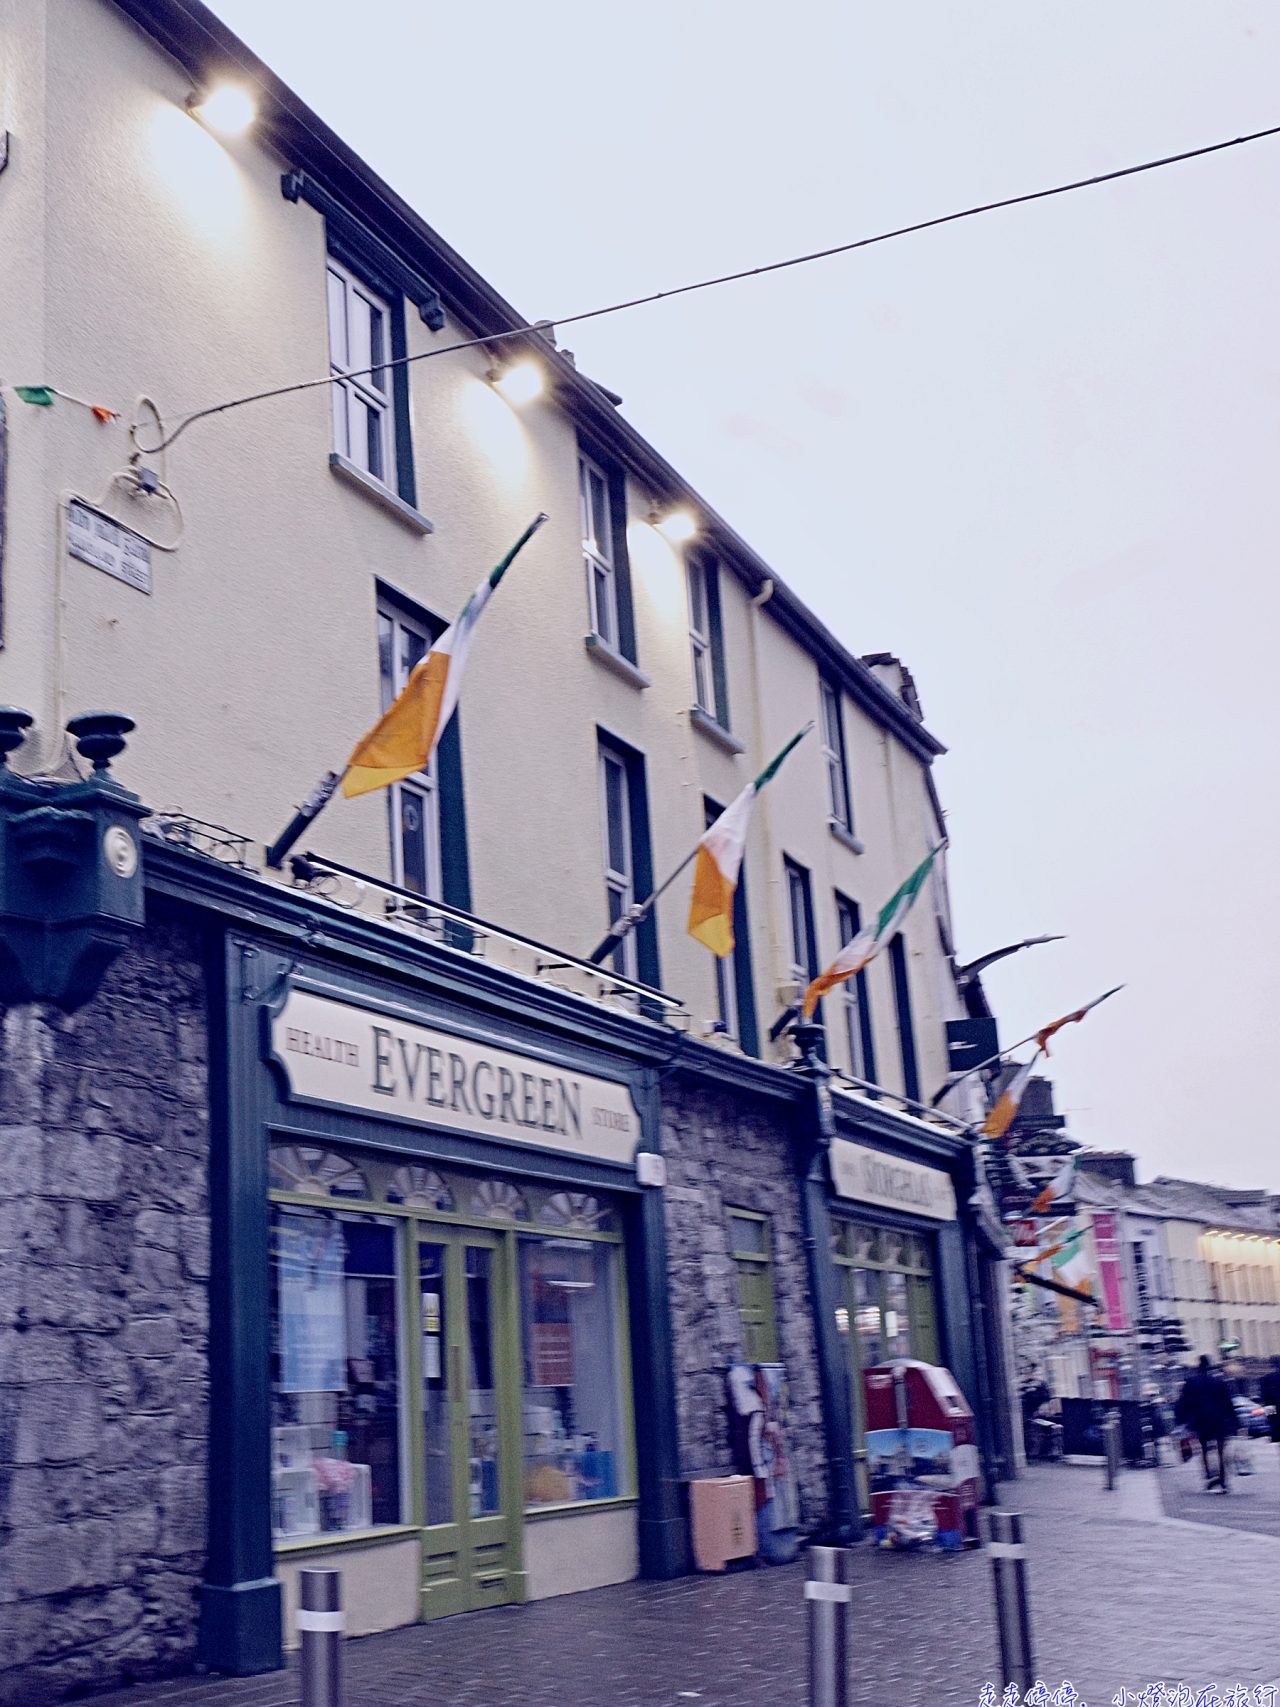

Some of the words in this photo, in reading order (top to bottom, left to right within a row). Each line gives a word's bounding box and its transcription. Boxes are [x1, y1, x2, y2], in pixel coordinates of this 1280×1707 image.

[286, 1026, 360, 1068] HEALTH
[370, 1025, 583, 1140] EVERGREEN
[592, 1106, 630, 1132] STORE
